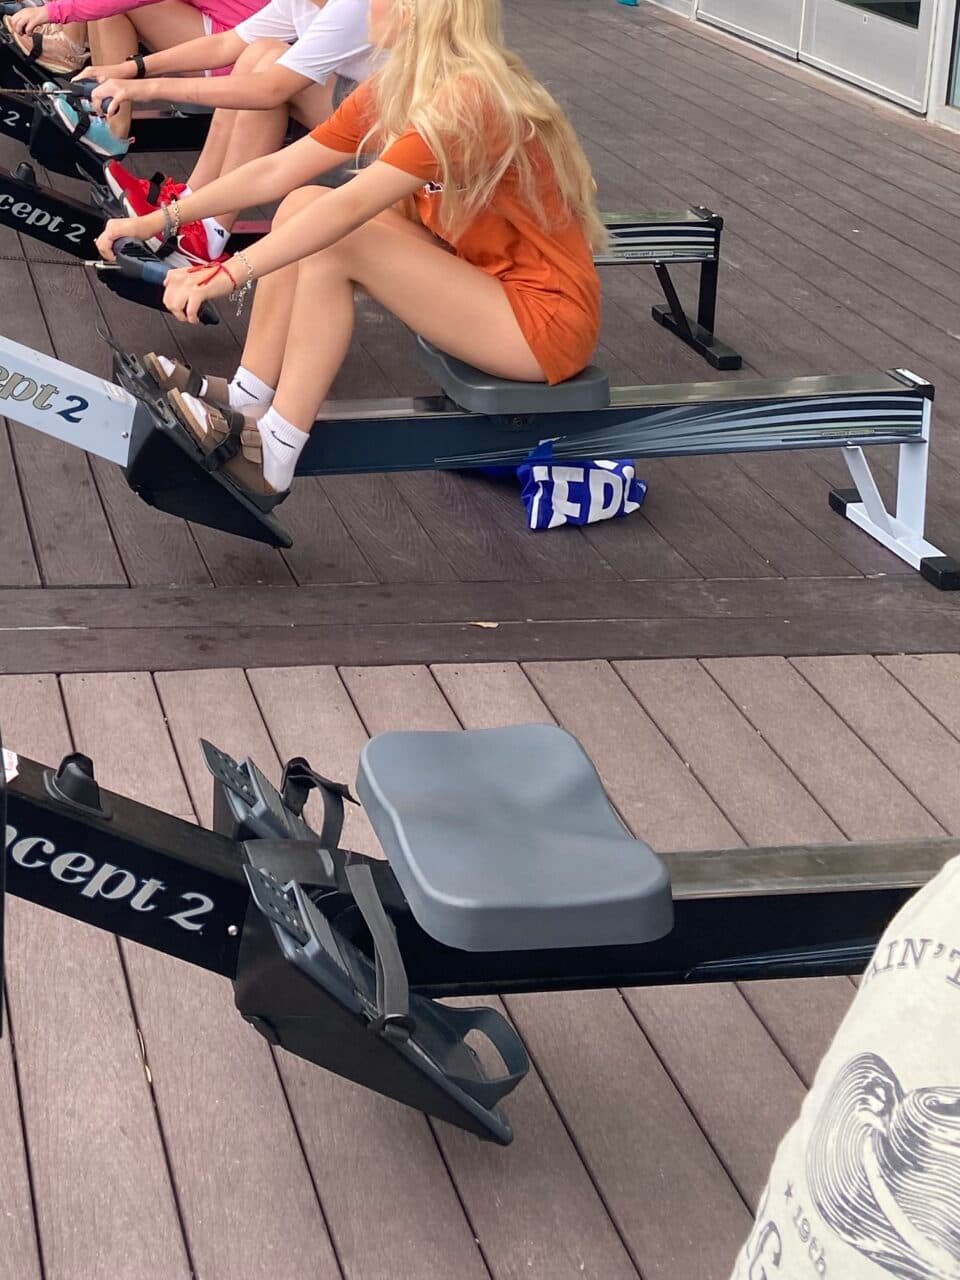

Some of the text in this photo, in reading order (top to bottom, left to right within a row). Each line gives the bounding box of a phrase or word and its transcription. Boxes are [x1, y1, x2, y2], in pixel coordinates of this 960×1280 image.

[4, 111, 20, 127] 2
[65, 223, 87, 243] 2
[56, 394, 89, 423] 2
[6, 825, 215, 931] cept 2
